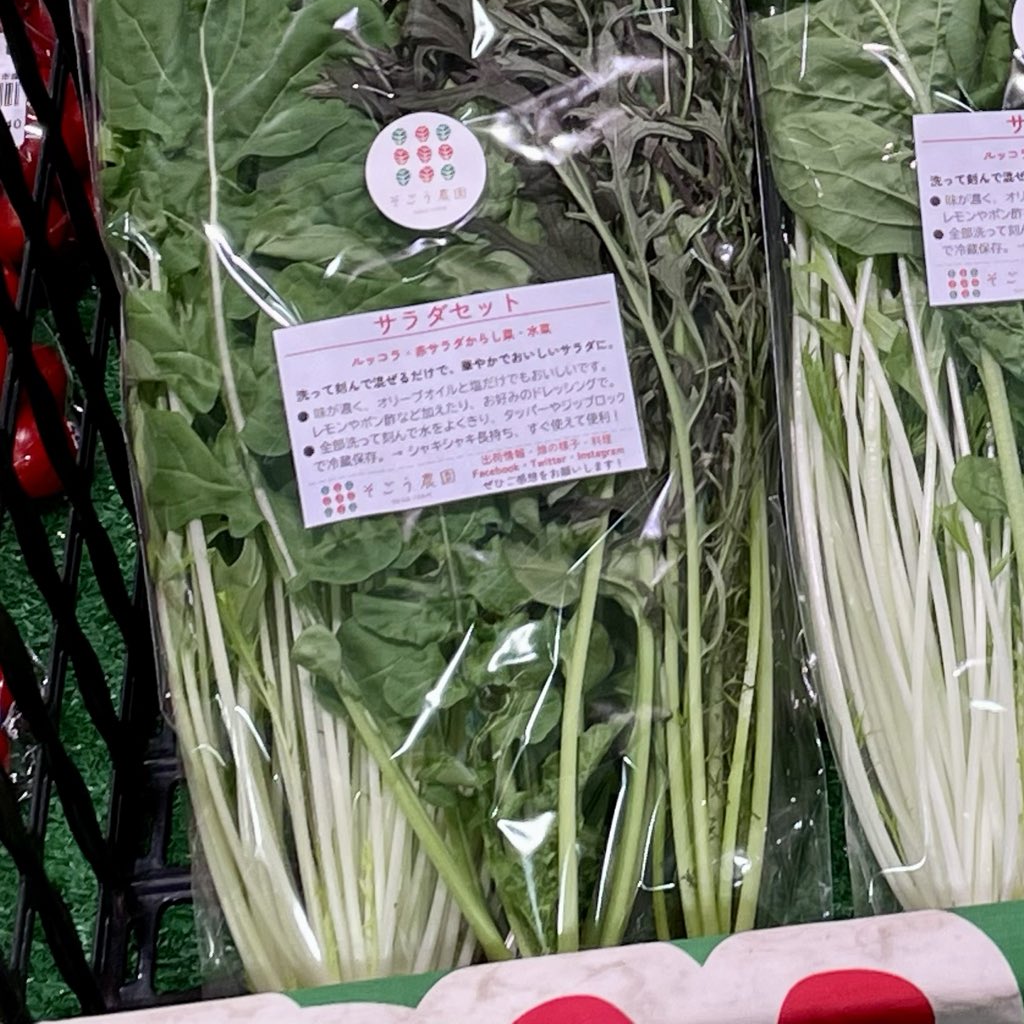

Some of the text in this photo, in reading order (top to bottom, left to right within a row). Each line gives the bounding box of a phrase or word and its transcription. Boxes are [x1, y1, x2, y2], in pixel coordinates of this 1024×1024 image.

[375, 293, 519, 335] サラダセット
[363, 468, 456, 497] そごう農園
